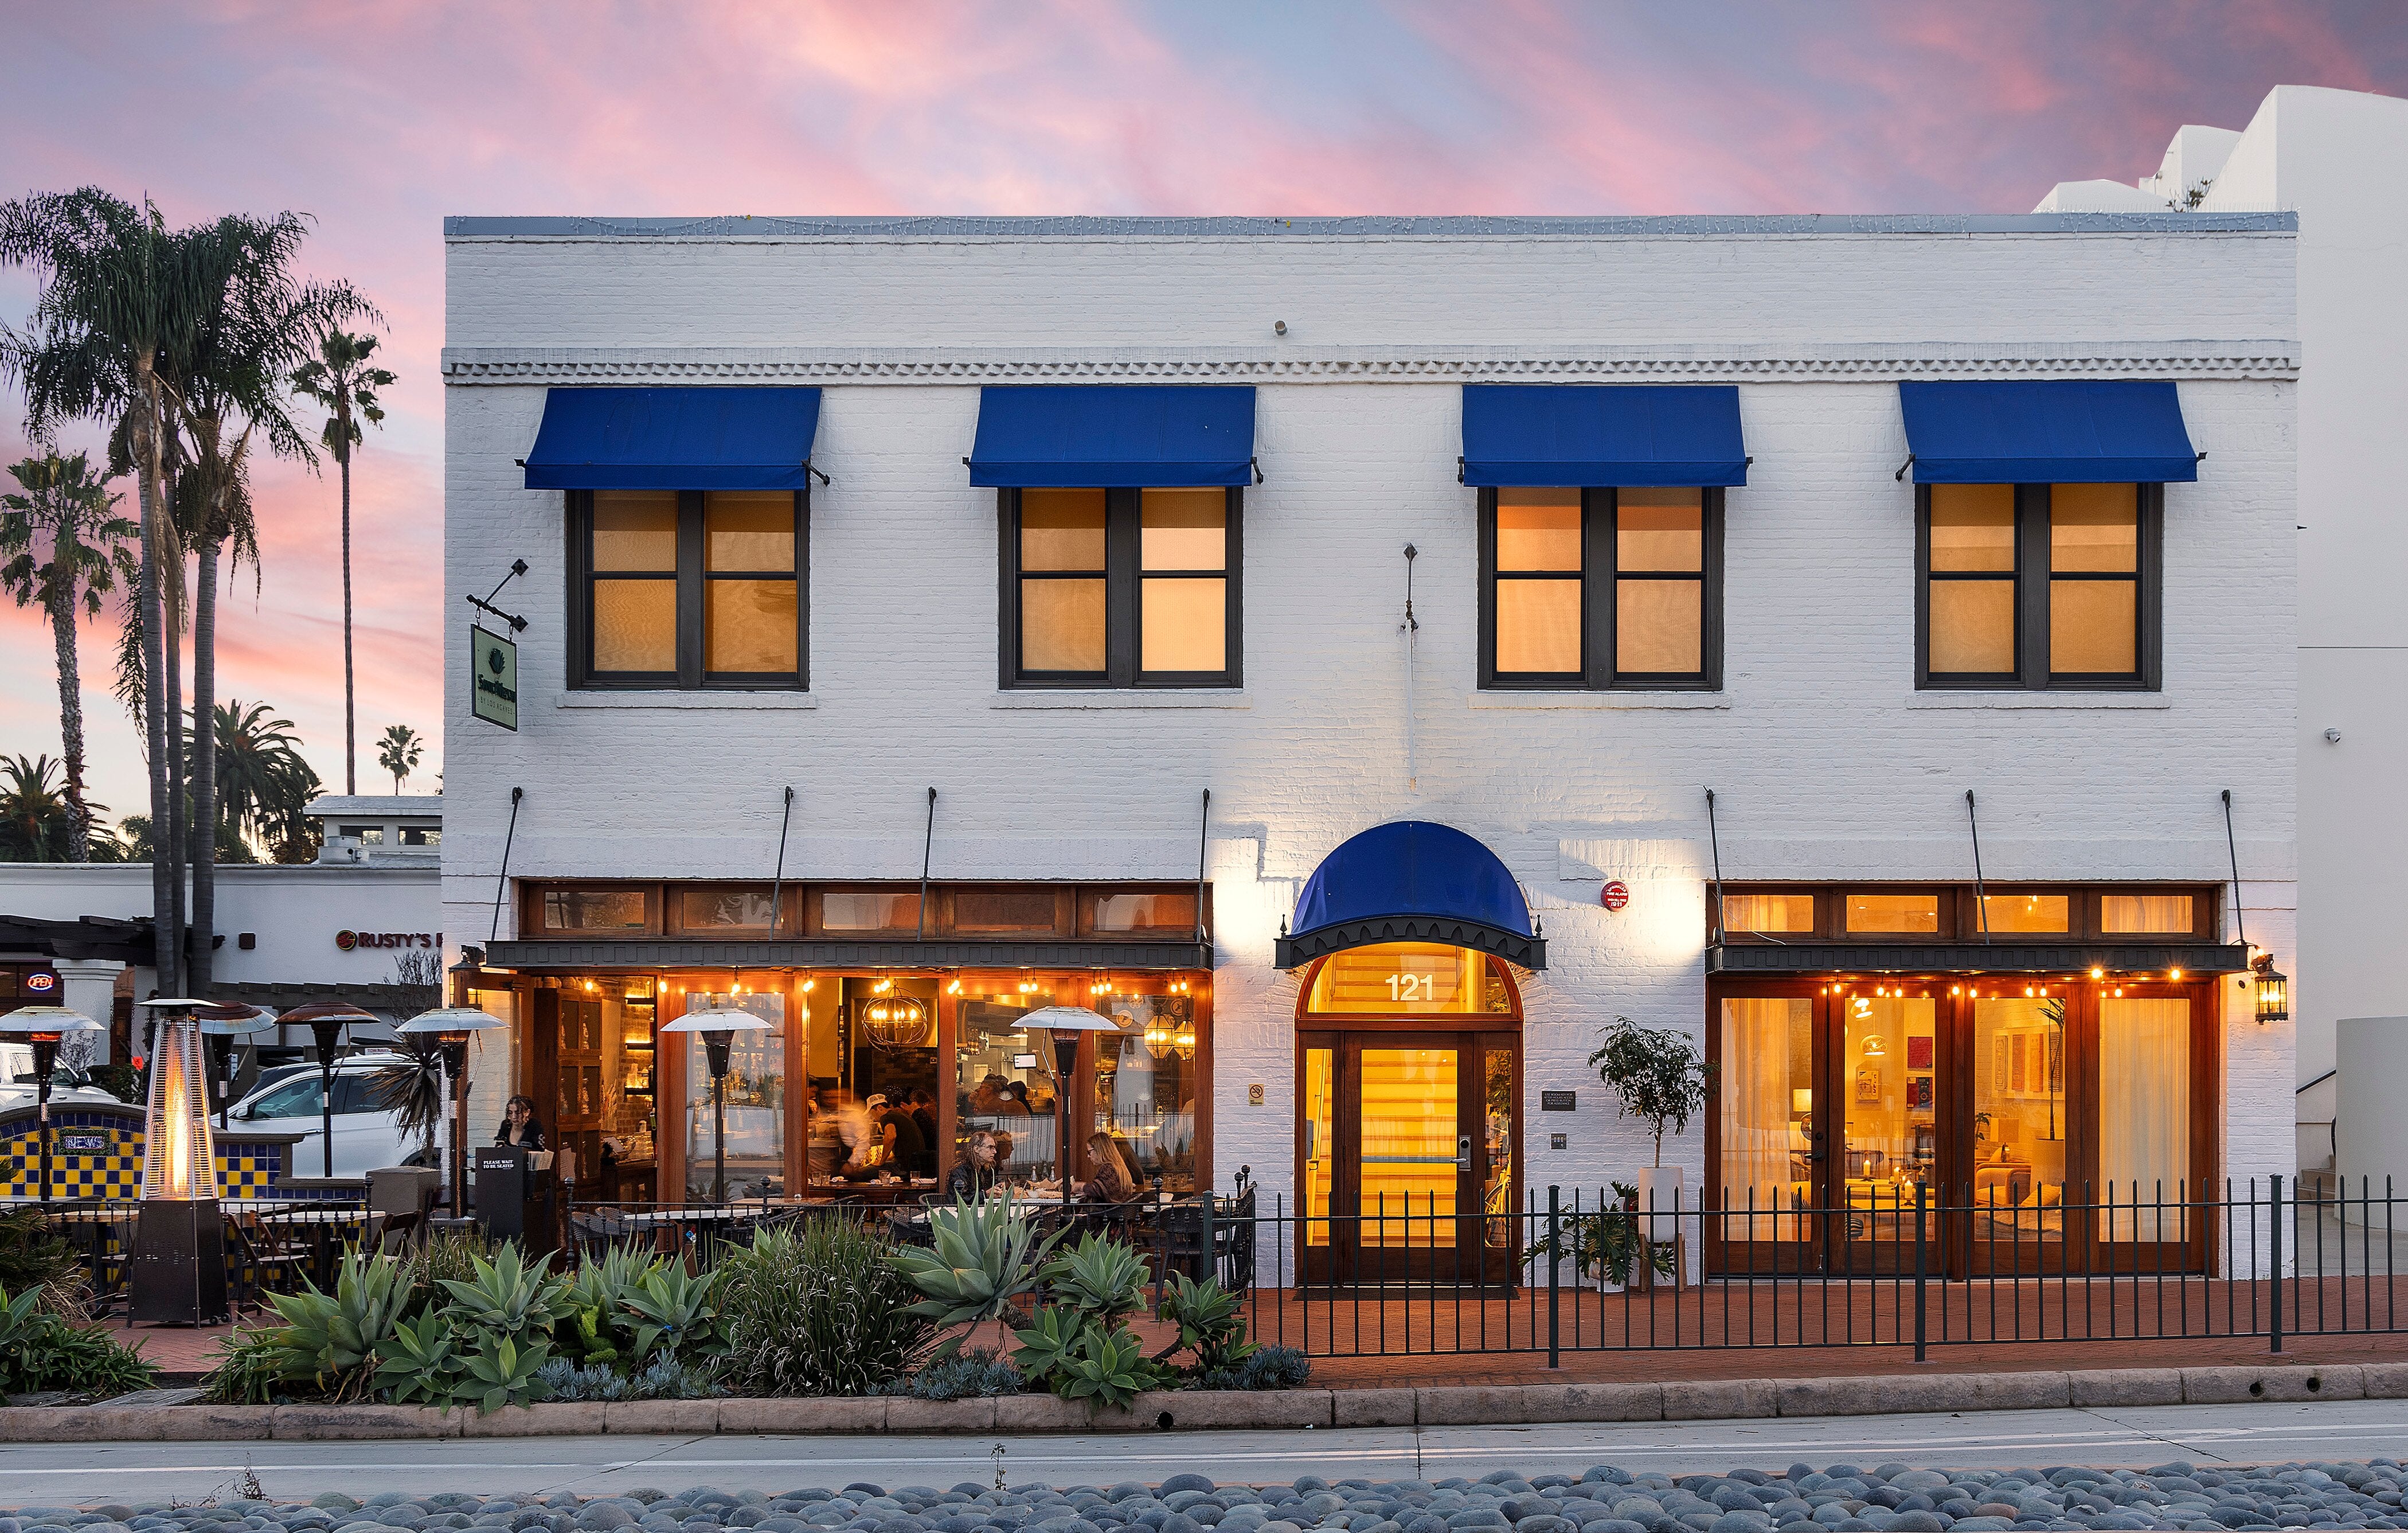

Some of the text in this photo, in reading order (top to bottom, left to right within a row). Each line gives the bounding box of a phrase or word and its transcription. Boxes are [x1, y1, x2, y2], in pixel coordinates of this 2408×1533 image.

[358, 932, 431, 947] RUSTY'S
[28, 977, 53, 986] OPEN
[1385, 974, 1433, 1001] 121
[67, 1137, 103, 1148] NEWS
